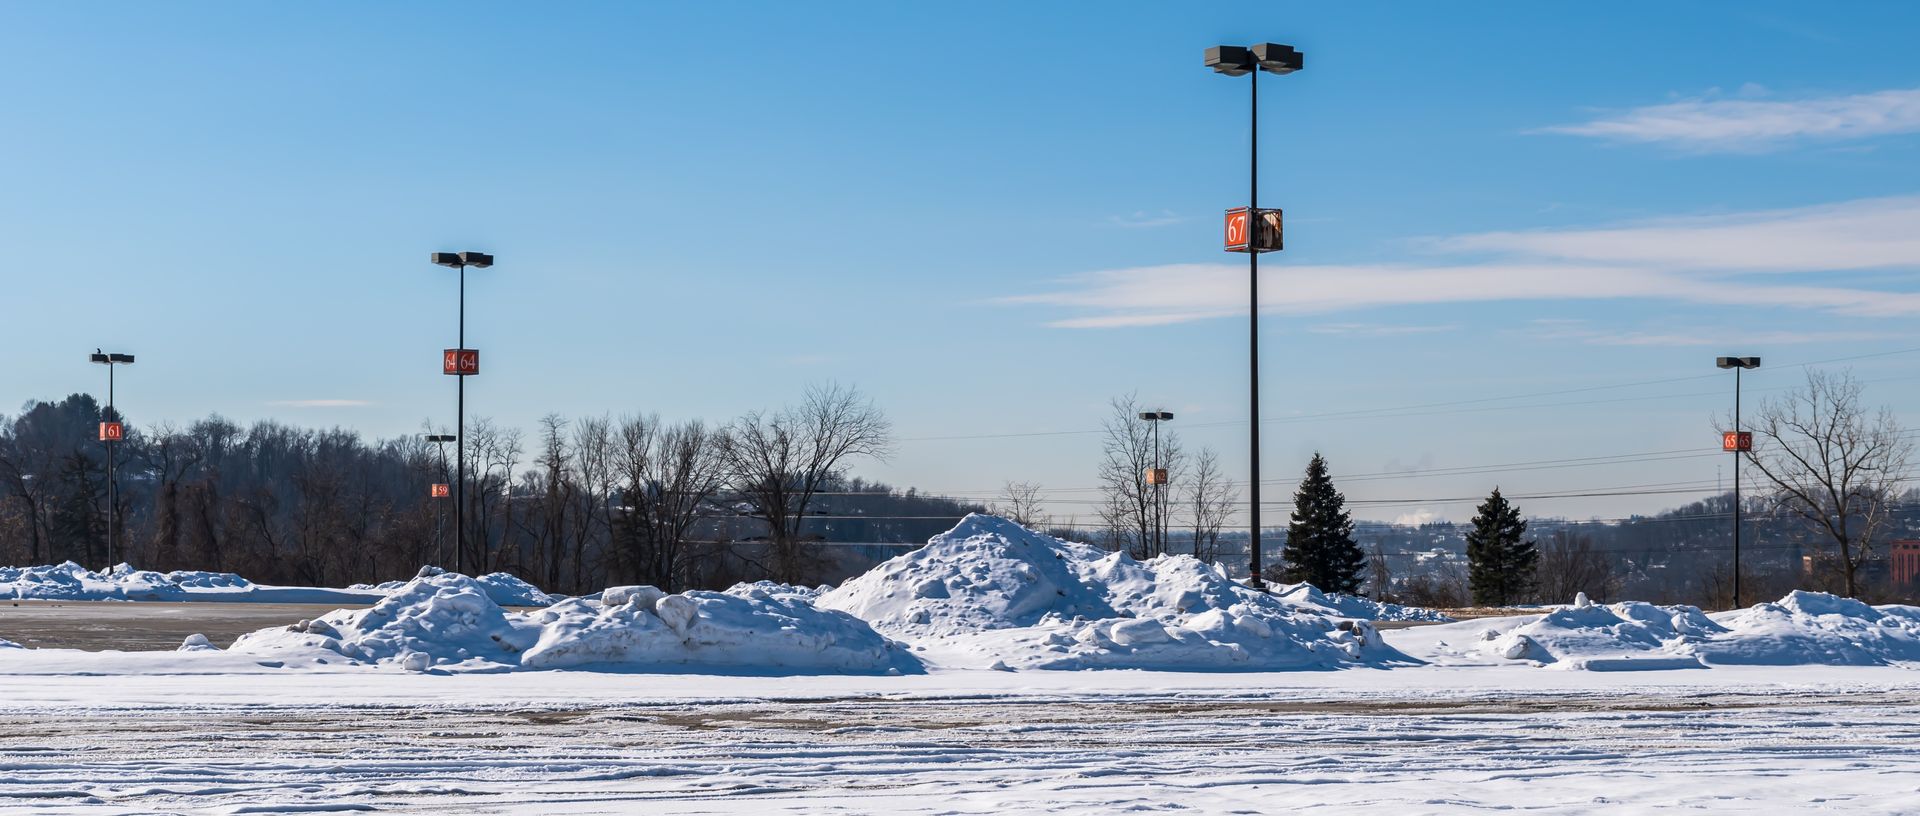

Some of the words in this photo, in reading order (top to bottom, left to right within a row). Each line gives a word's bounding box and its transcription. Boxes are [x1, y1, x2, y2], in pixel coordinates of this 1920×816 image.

[1228, 216, 1245, 242] 67
[446, 354, 455, 369] 64
[460, 354, 475, 369] 64
[108, 426, 120, 437] 61
[1725, 436, 1735, 447] 65
[1740, 437, 1749, 447] 65
[439, 486, 447, 495] 59
